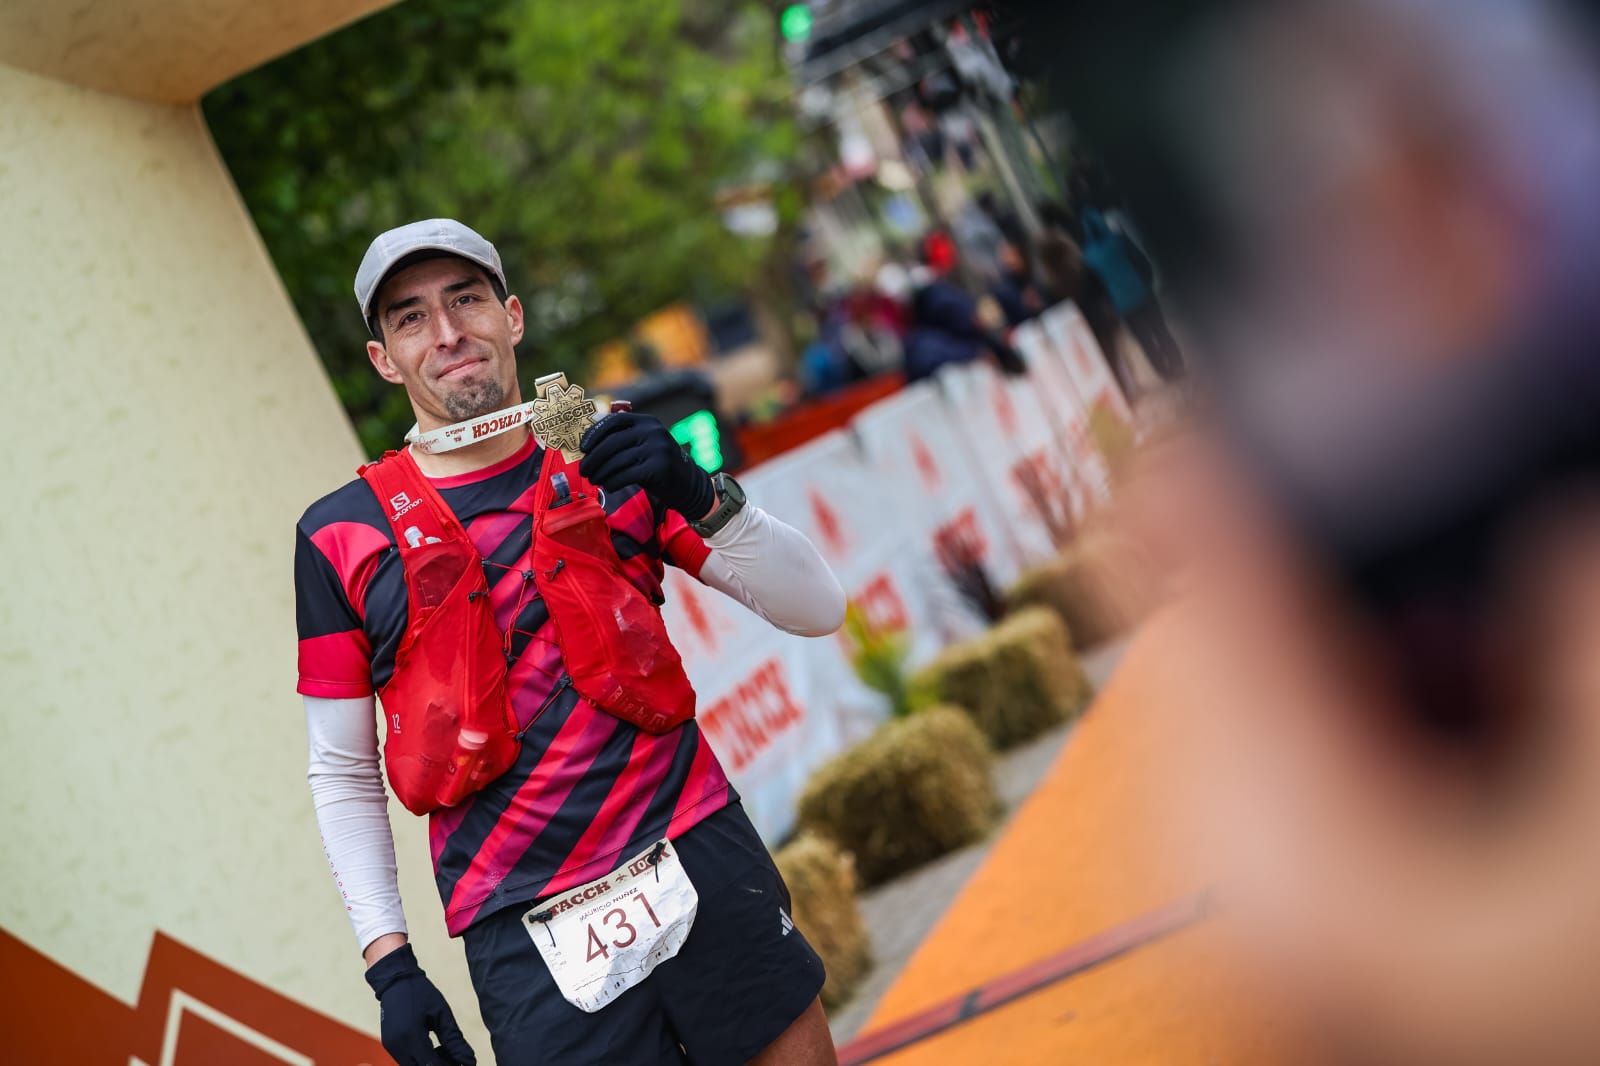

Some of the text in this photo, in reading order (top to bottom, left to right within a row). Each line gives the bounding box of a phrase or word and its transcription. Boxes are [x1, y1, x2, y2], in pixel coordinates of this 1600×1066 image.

[472, 410, 522, 439] UTACCH
[536, 880, 611, 921] TACCH
[579, 900, 612, 922] MAURICIO
[585, 891, 662, 964] 431
